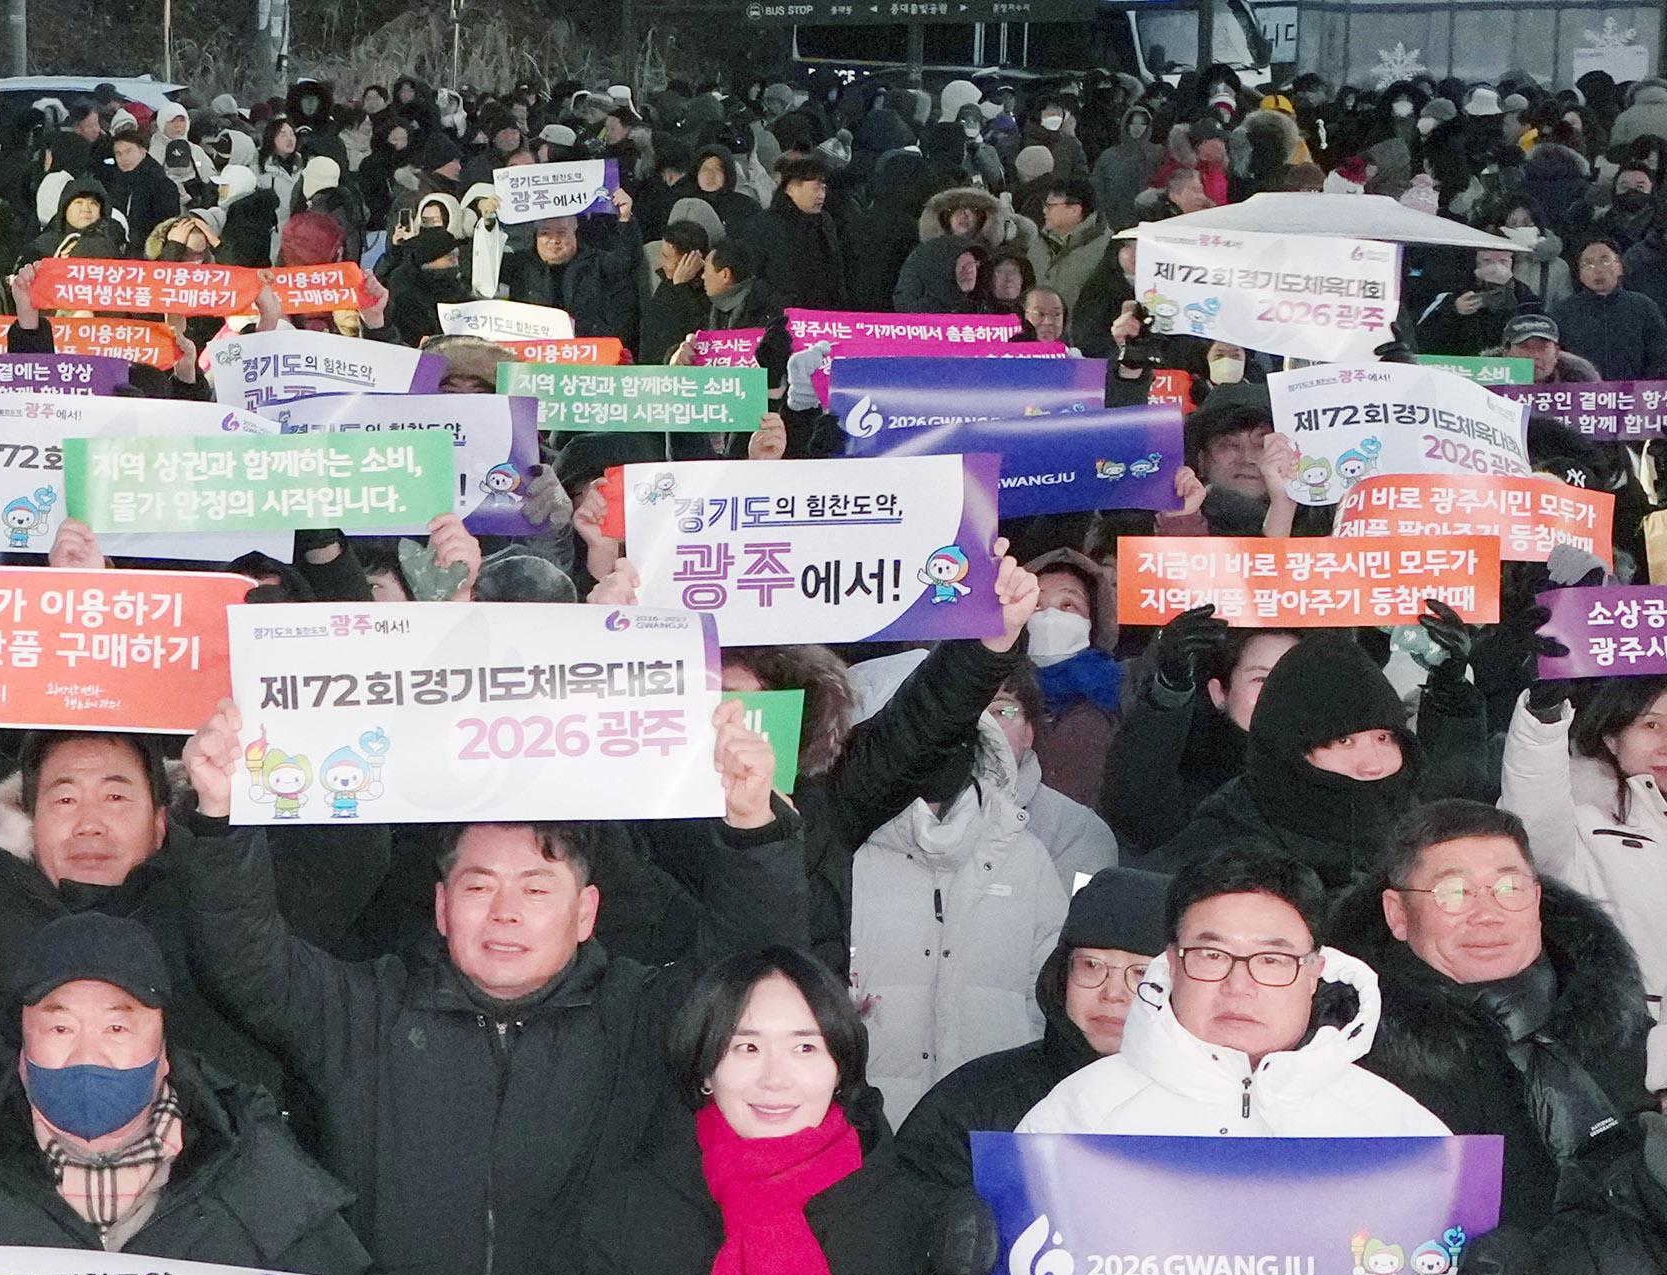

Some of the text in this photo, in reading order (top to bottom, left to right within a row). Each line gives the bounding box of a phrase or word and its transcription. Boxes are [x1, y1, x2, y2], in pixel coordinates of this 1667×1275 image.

[765, 5, 813, 15] BUS STOP
[1257, 298, 1384, 332] 2026 광주
[1294, 404, 1389, 434] 제72회
[93, 454, 145, 479] 지역
[155, 451, 233, 478] 상권과
[244, 449, 350, 477] 함께하는
[113, 492, 166, 520] 물가
[175, 489, 255, 517] 안정의
[673, 497, 795, 533] 경기도의
[1138, 551, 1478, 579] 지금이 바로 광주시민 모두가
[42, 591, 182, 629] 이용하기
[1253, 590, 1360, 617] 팔아주기
[57, 634, 199, 671] 구매하기
[261, 659, 684, 711] 제72회 경기도체육대회
[457, 709, 687, 760] 2026 광주
